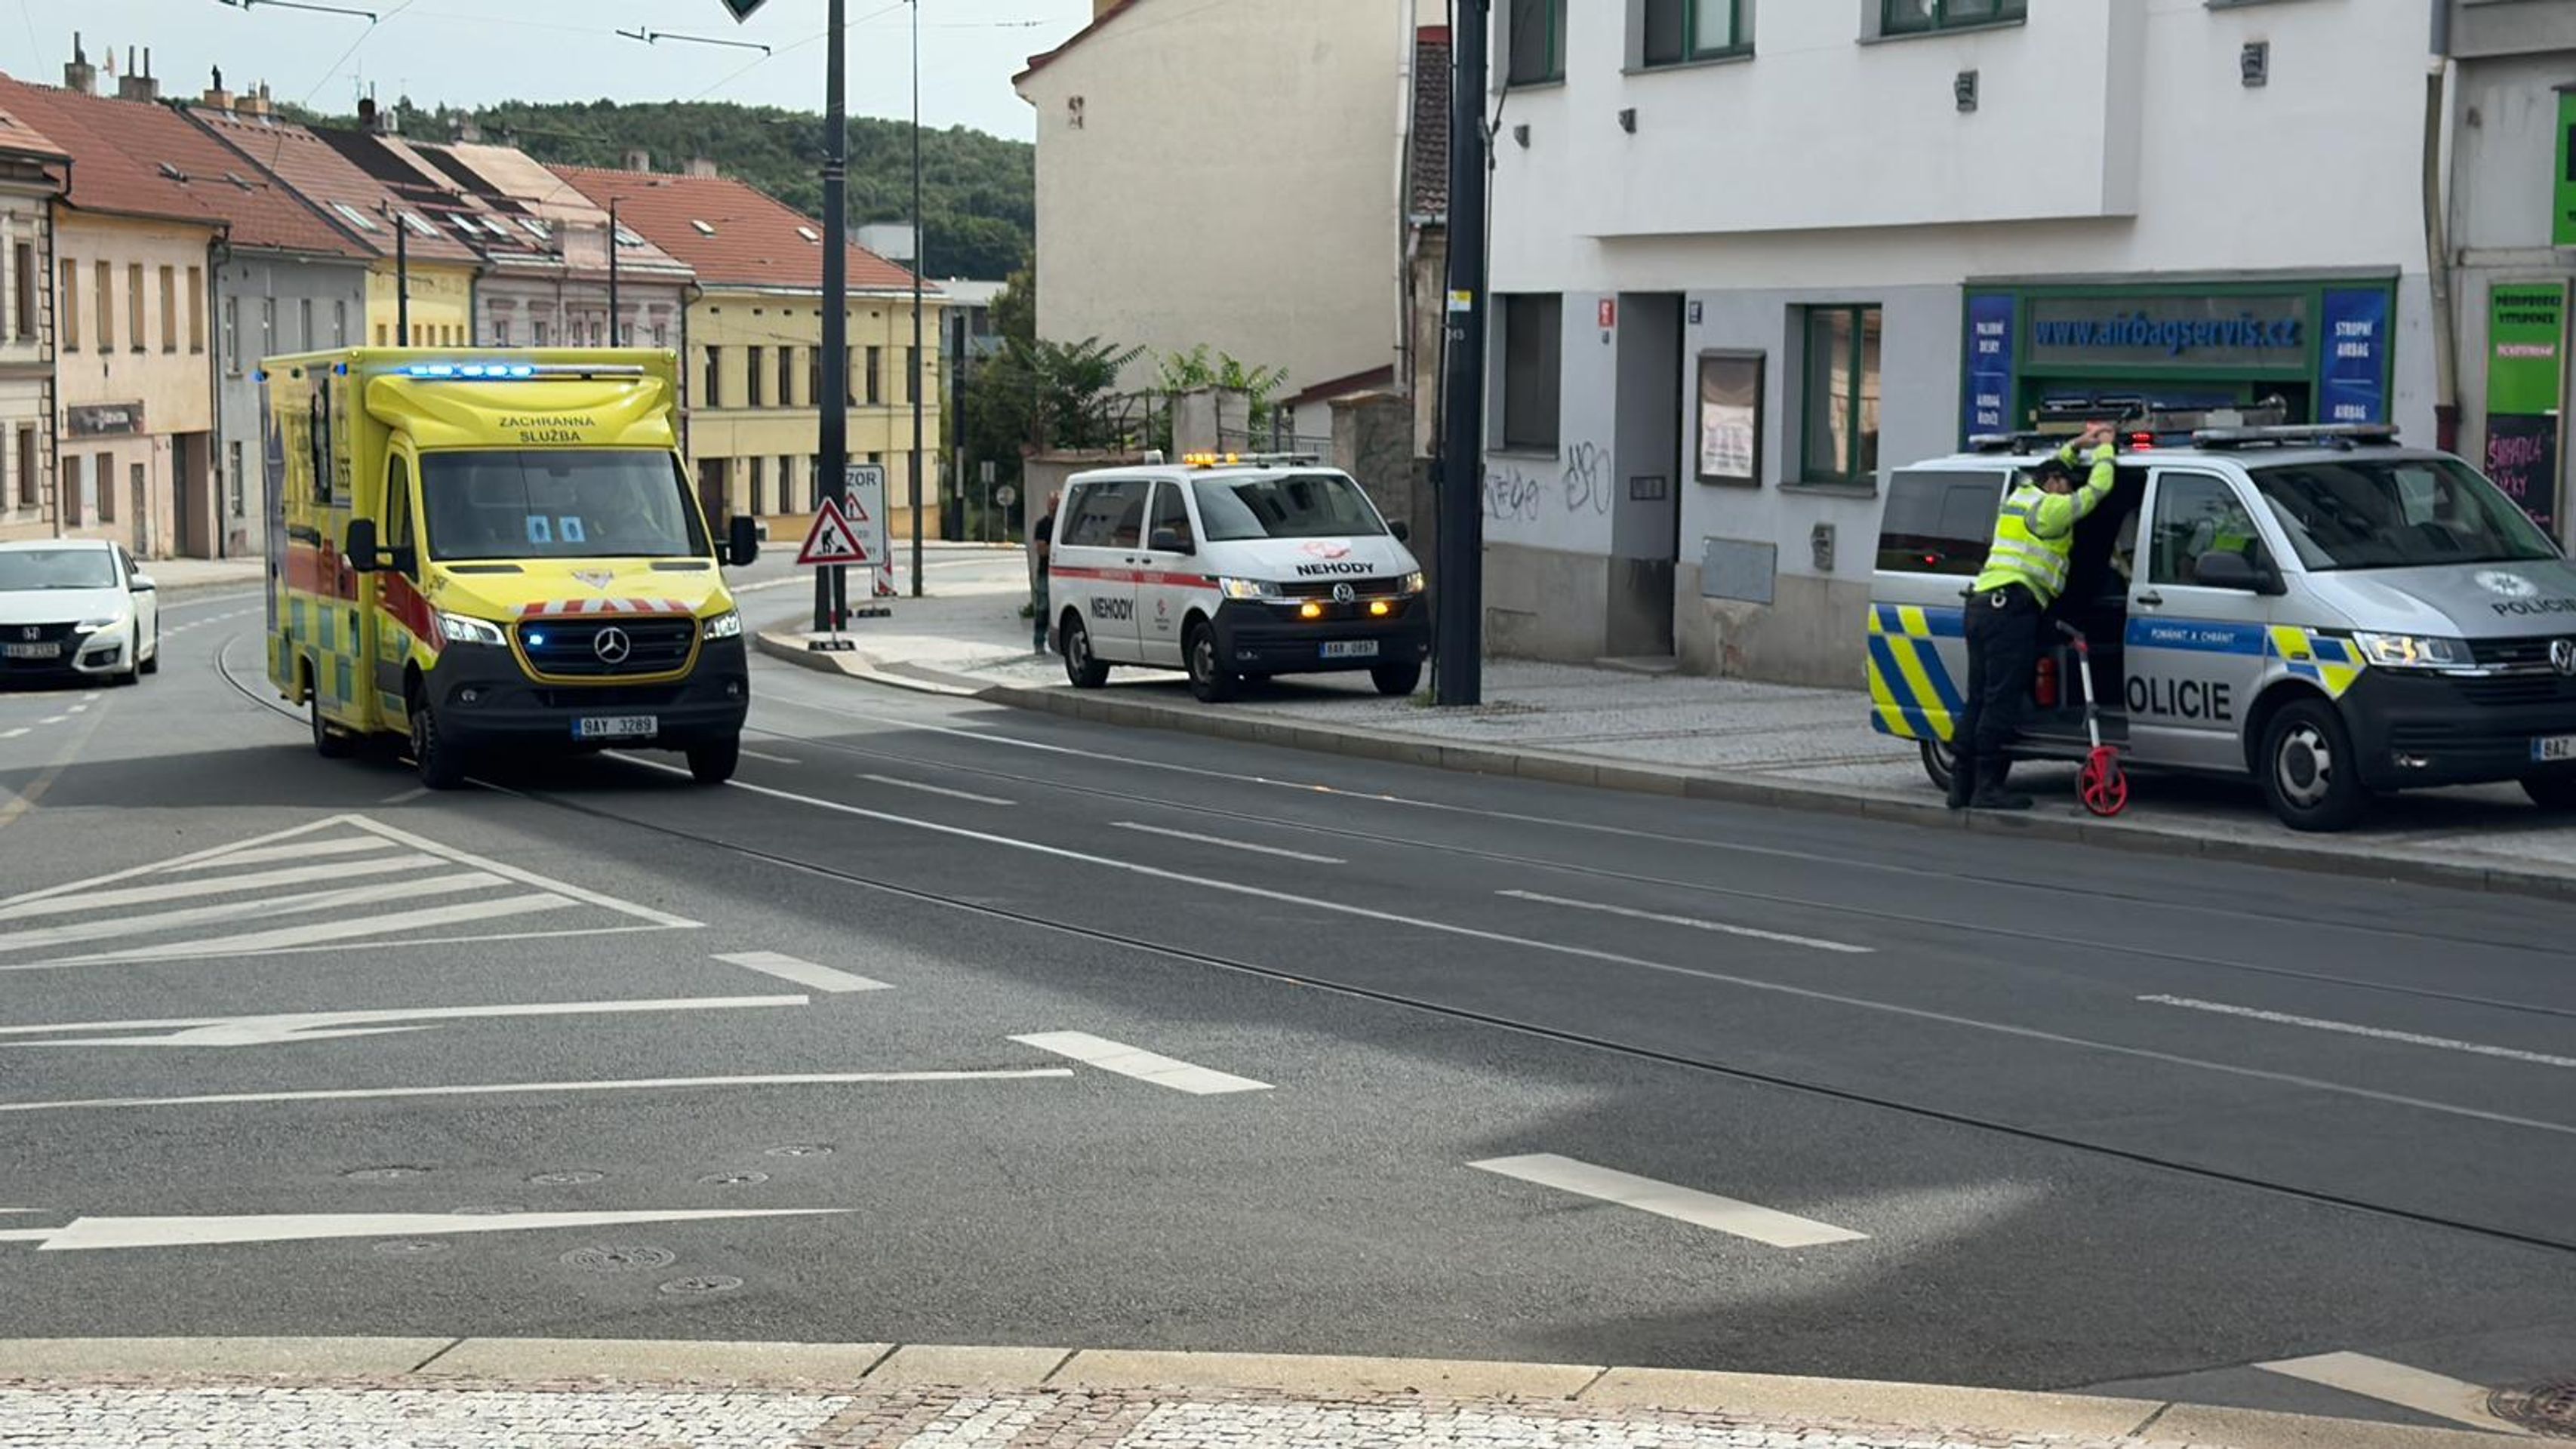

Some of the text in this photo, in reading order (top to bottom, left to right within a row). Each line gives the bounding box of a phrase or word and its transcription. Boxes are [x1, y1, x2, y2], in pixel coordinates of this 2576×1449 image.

[2035, 310, 2298, 355] www.airbagservis.cz
[845, 472, 878, 486] ZOR
[1296, 561, 1373, 576] NEHODY
[1091, 597, 1134, 620] NEHODY
[2126, 675, 2233, 722] OLICIE
